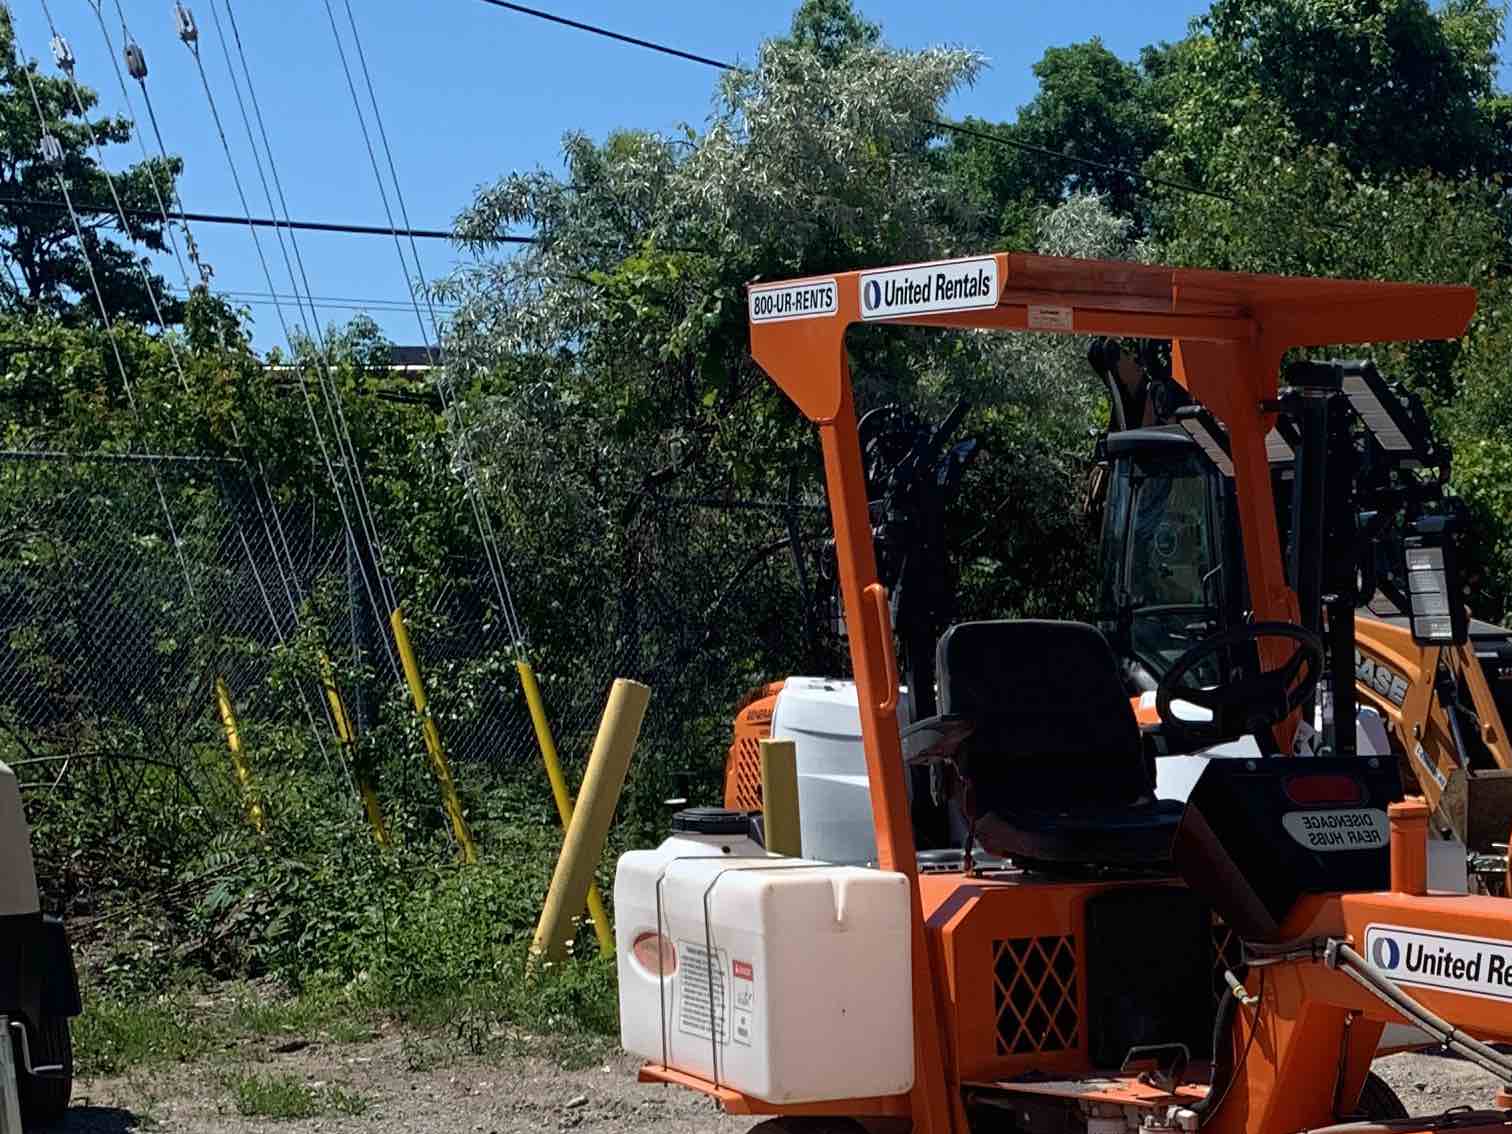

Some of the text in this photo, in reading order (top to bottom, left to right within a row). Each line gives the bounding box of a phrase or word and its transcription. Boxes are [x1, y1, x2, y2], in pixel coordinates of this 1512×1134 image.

[754, 287, 833, 315] 800-UR-RENTS
[884, 268, 990, 307] United Rentals
[1355, 648, 1409, 704] ASE
[1405, 942, 1482, 982] United
